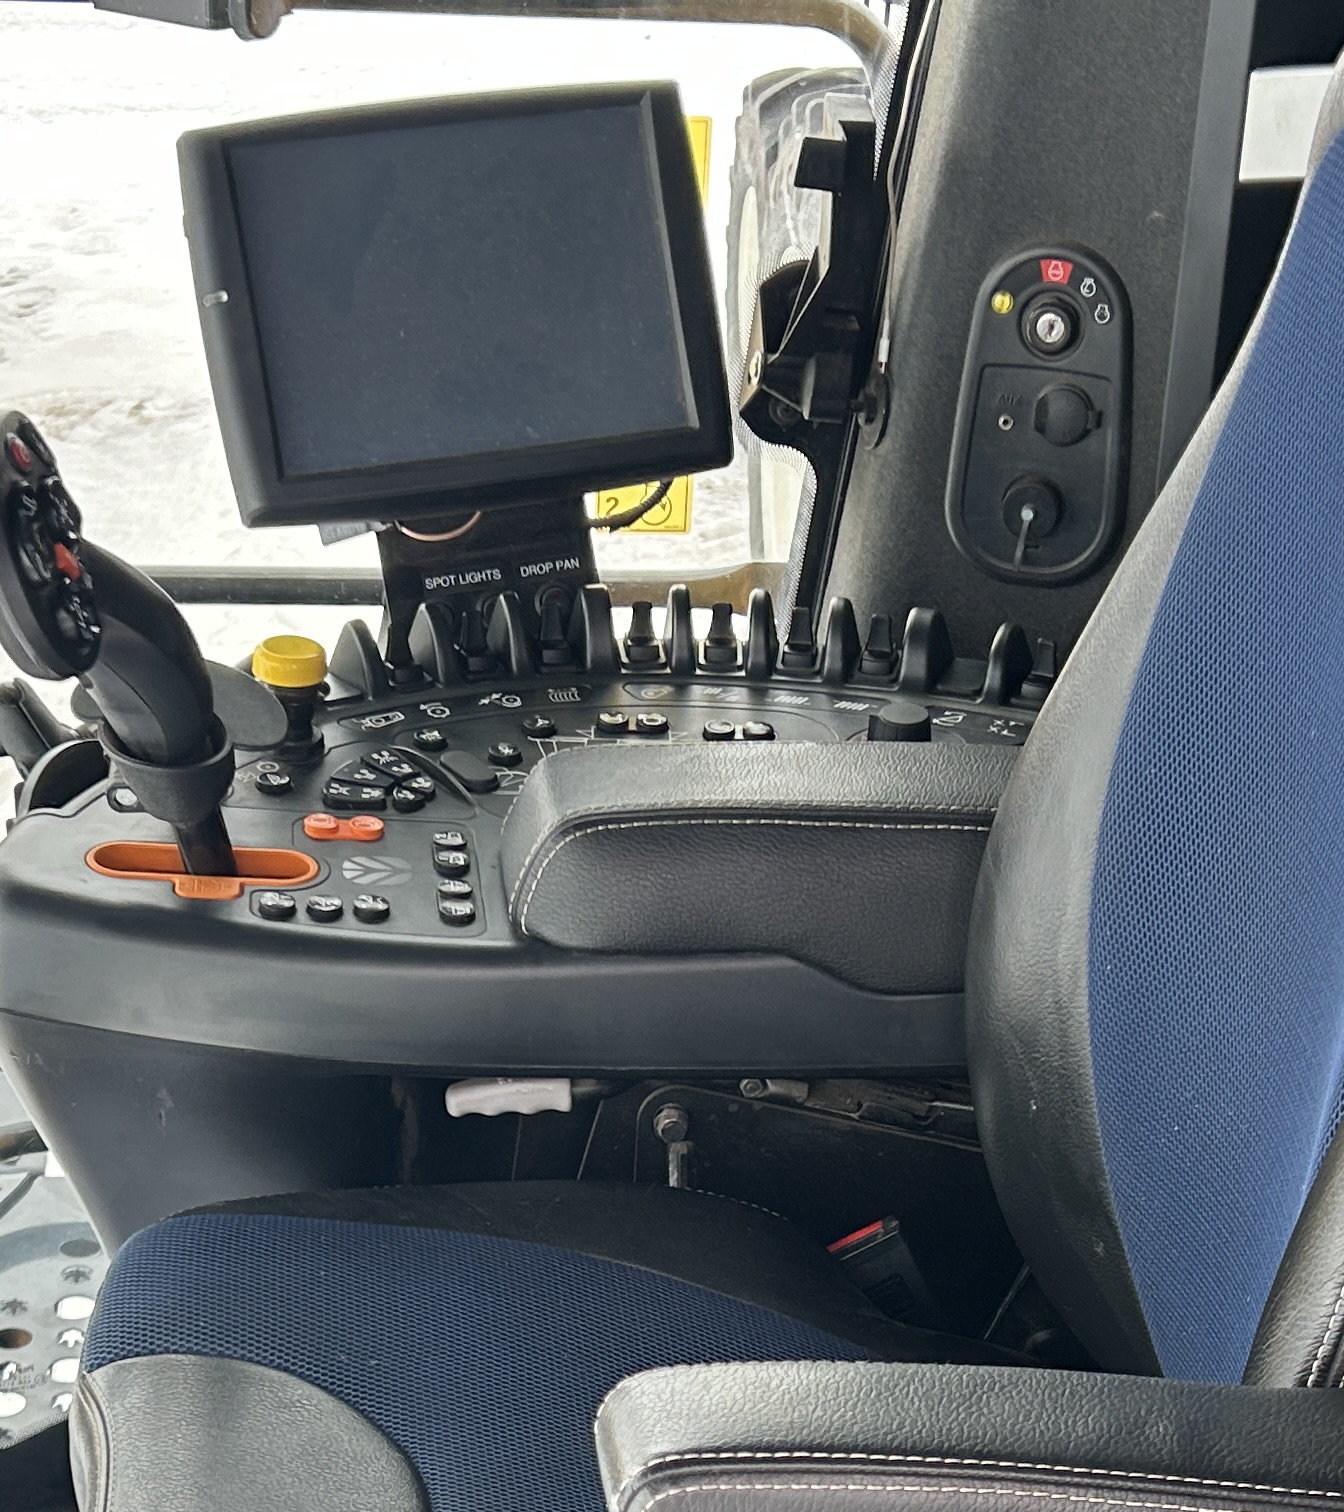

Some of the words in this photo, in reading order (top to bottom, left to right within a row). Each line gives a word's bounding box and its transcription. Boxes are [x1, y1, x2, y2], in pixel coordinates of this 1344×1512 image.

[519, 562, 554, 578] DROP
[556, 557, 581, 572] PAN
[424, 574, 456, 590] SPOT
[459, 568, 502, 586] LIGHTS
